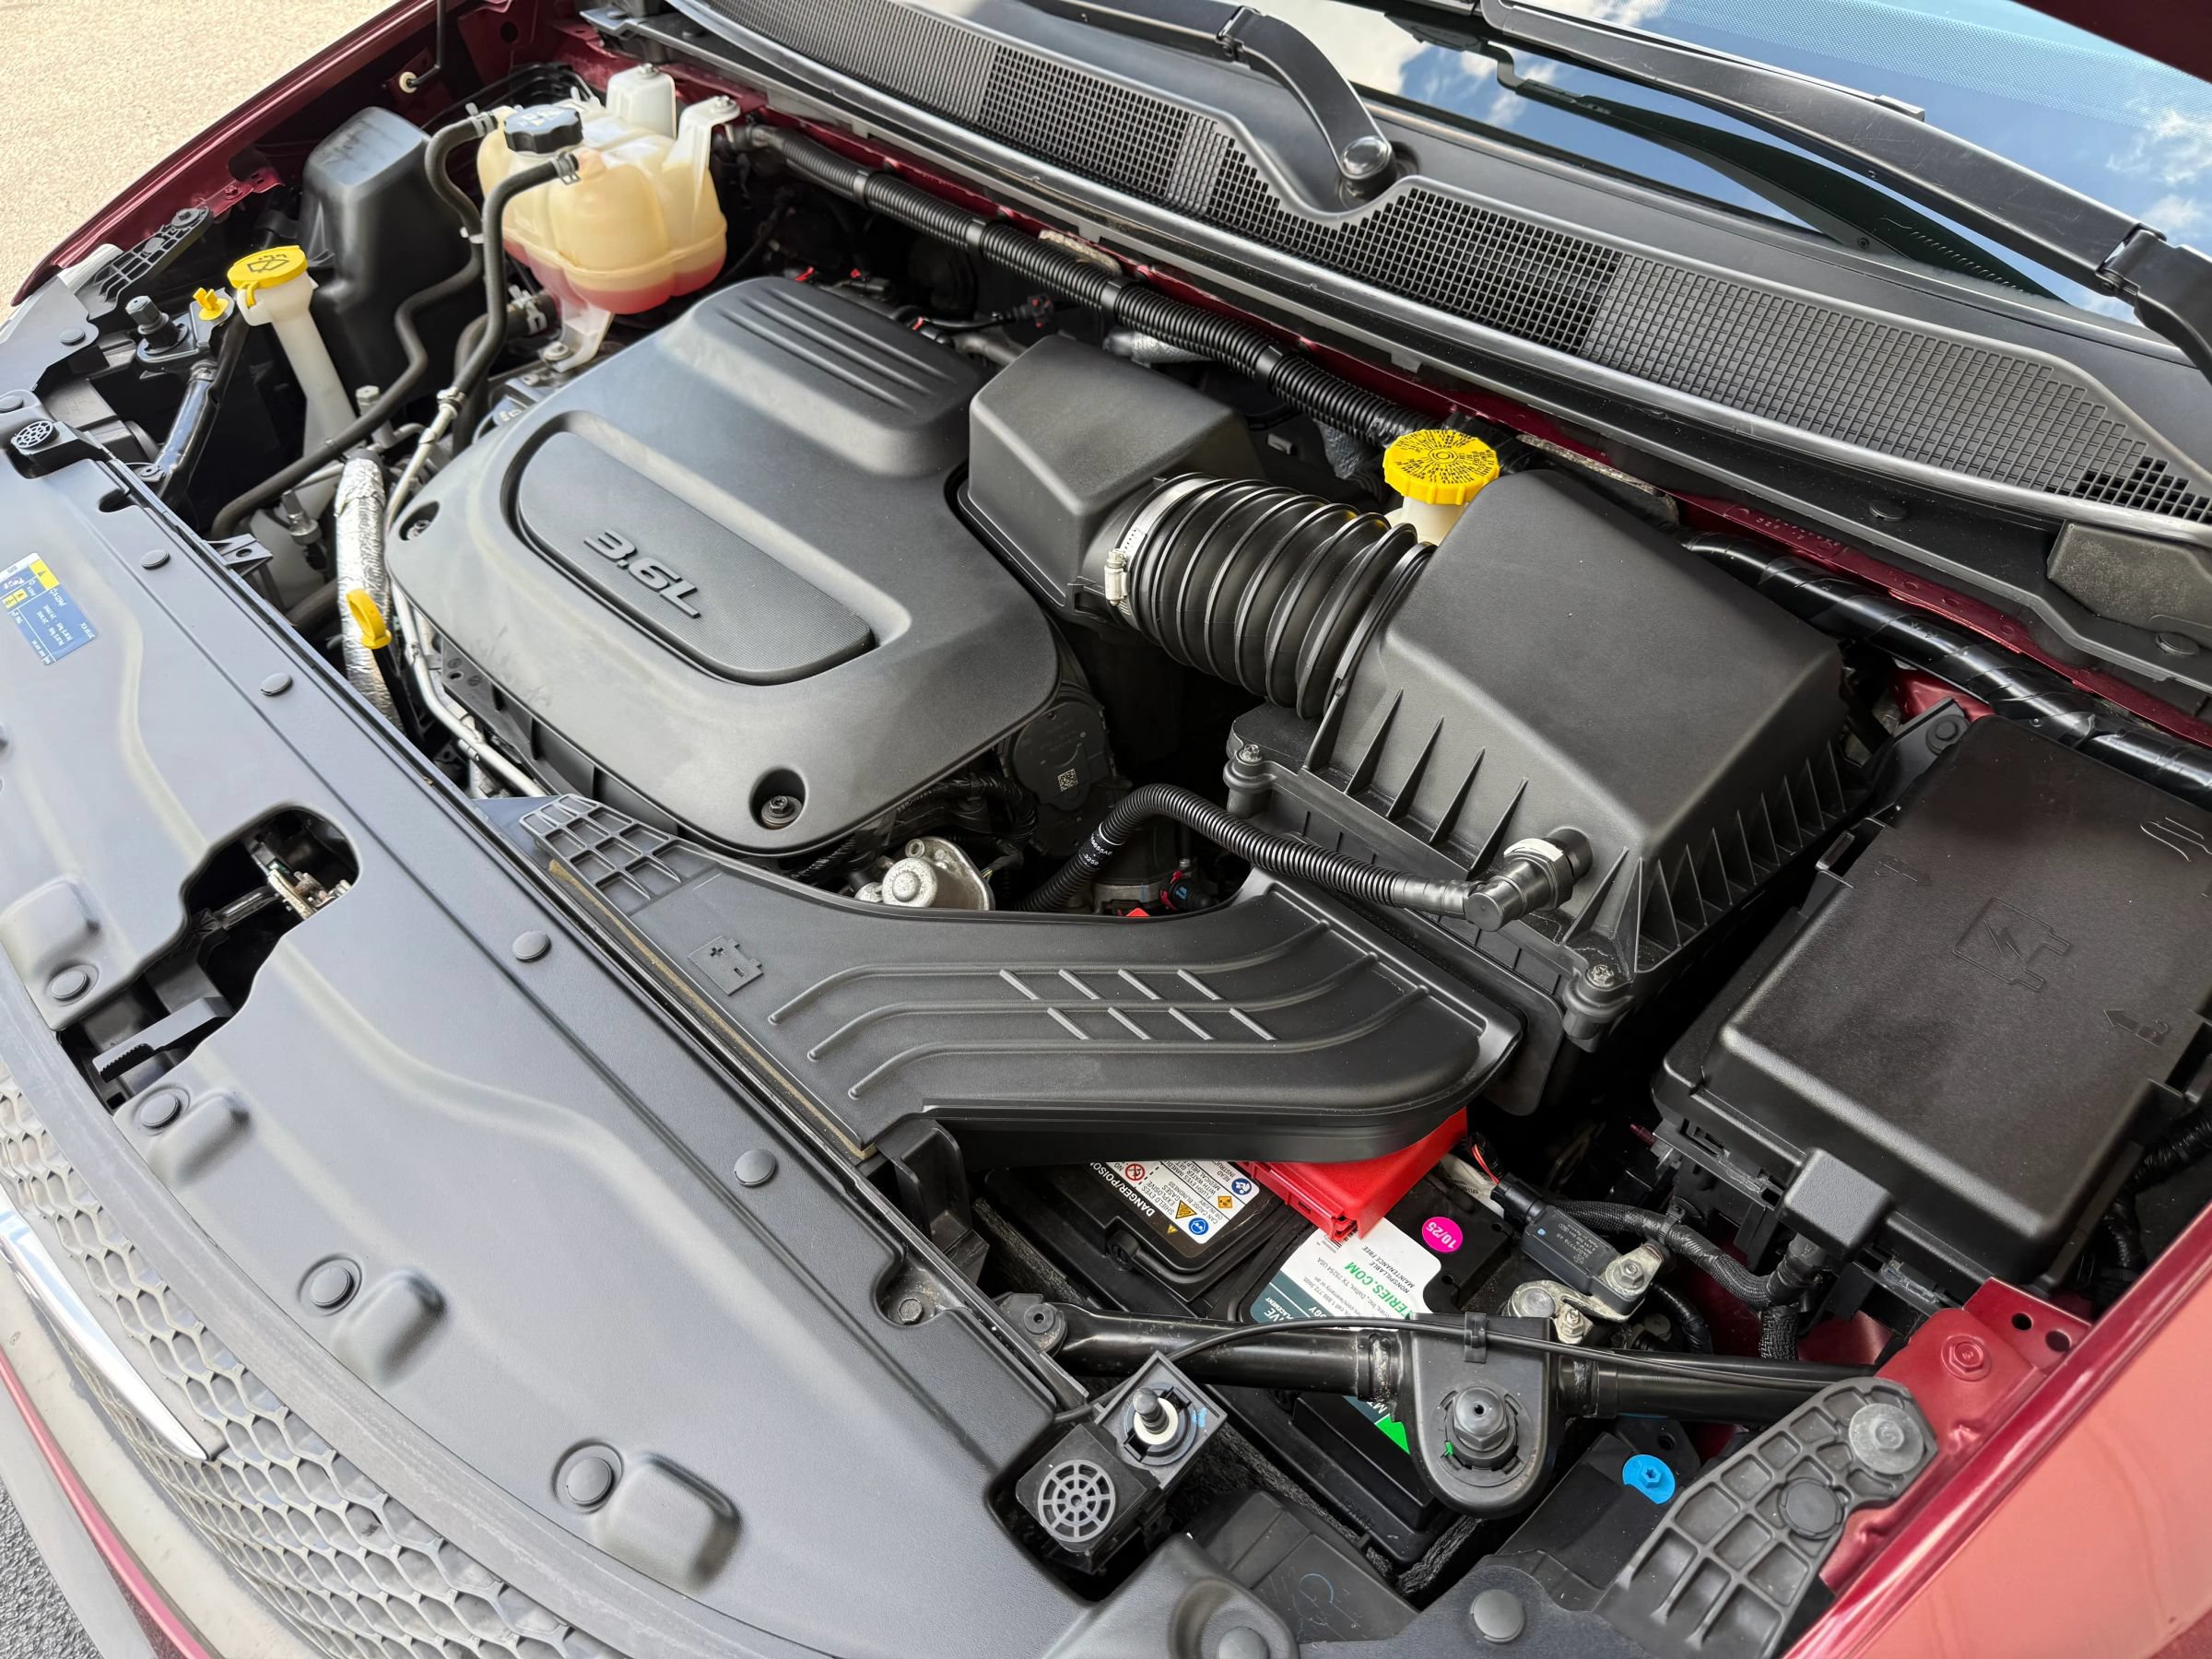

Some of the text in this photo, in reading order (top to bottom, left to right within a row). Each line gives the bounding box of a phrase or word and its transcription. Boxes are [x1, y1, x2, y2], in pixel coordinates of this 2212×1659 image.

[583, 529, 701, 619] 3.6L
[1176, 1160, 1186, 1170] GET
[1186, 1161, 1220, 1190] MEDICAL HELP
[1217, 1169, 1230, 1182] READ
[1088, 1161, 1155, 1217] DANGER/POISO
[1183, 1174, 1196, 1186] EYES
[1194, 1184, 1211, 1198] FLUSH
[1202, 1182, 1216, 1194] WITH
[1141, 1185, 1174, 1215] SHIELD EYES
[1146, 1180, 1175, 1206] EXPLOSIVE
[1161, 1183, 1180, 1201] GASES
[1168, 1180, 1218, 1224] CAN CAUSE BLINDNESS
[1198, 1198, 1216, 1214] INJURY
[1426, 1222, 1458, 1250] 10/25
[1316, 1256, 1328, 1267] USA
[1361, 1244, 1377, 1258] FREE
[1369, 1260, 1409, 1294] NONSPILLABLE
[1374, 1256, 1415, 1288] MAINTENANCE
